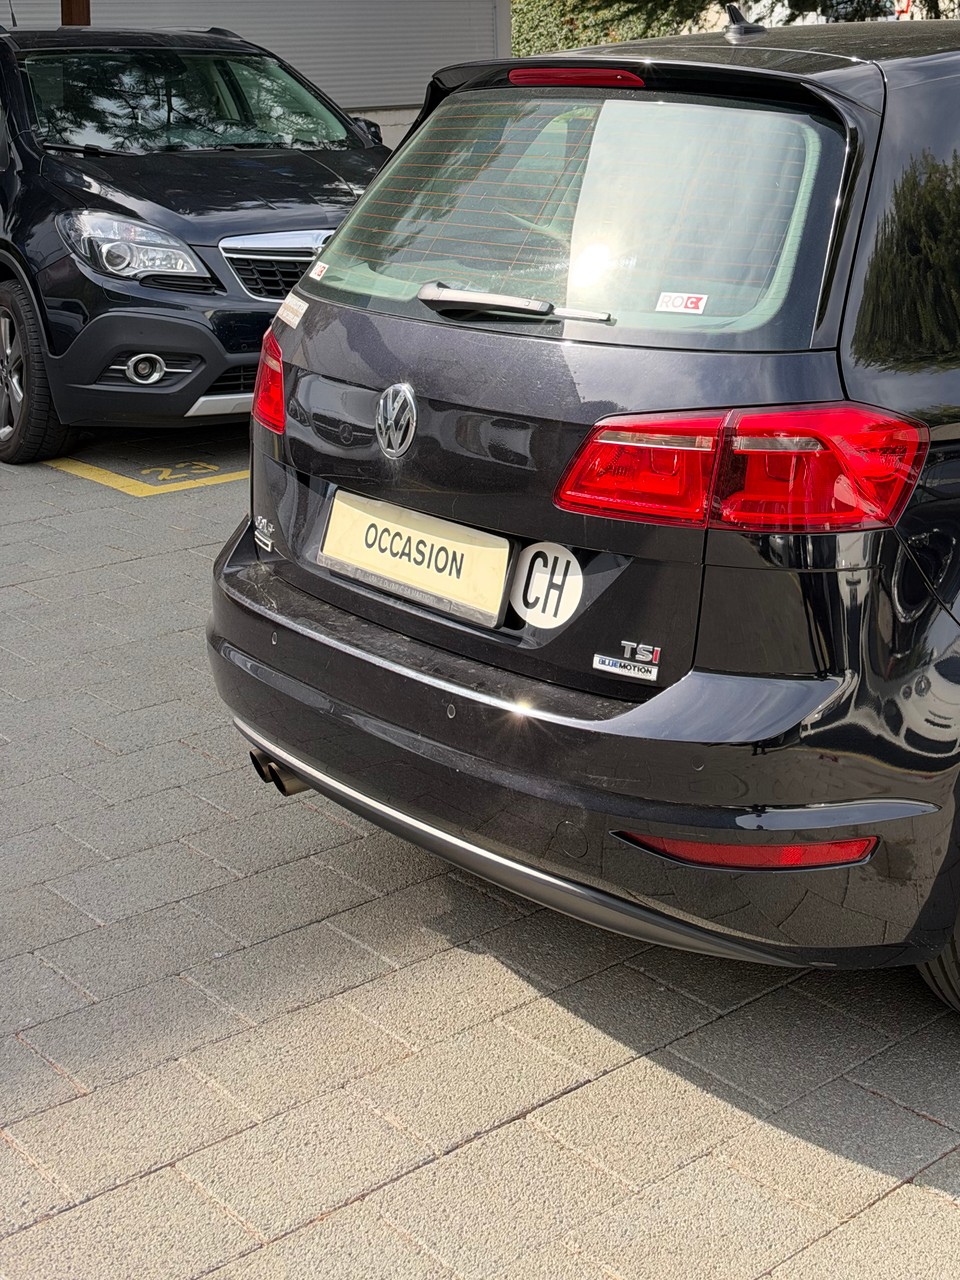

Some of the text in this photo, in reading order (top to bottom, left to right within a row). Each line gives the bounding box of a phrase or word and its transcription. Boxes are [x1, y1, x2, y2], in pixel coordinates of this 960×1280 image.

[365, 523, 464, 579] OCCASION
[522, 550, 571, 618] CH
[621, 640, 661, 663] TSI
